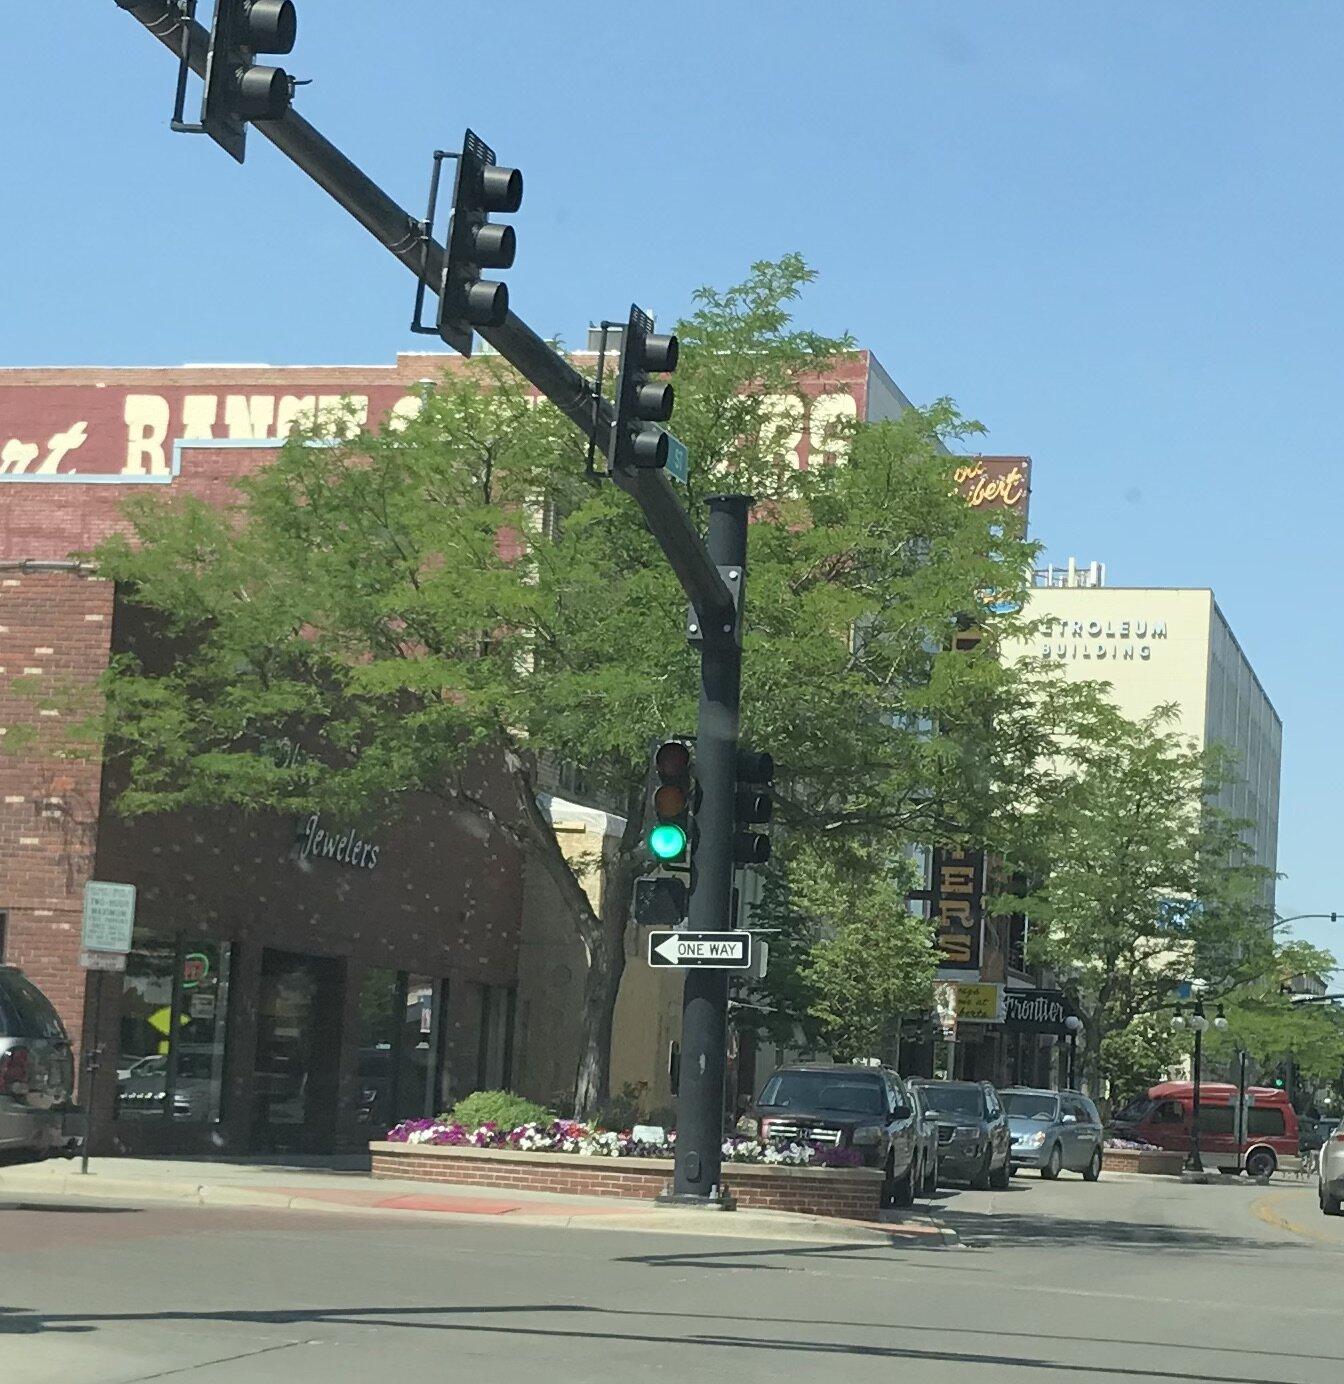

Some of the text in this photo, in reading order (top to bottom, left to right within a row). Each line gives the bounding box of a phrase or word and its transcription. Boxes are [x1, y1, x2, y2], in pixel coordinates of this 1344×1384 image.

[121, 394, 369, 475] RAN
[1040, 618, 1168, 640] ETROLEUM
[1042, 643, 1152, 661] BUILDING
[300, 815, 380, 869] Jewelers
[678, 943, 737, 957] ONE WAY
[1005, 993, 1064, 1023] Frontier
